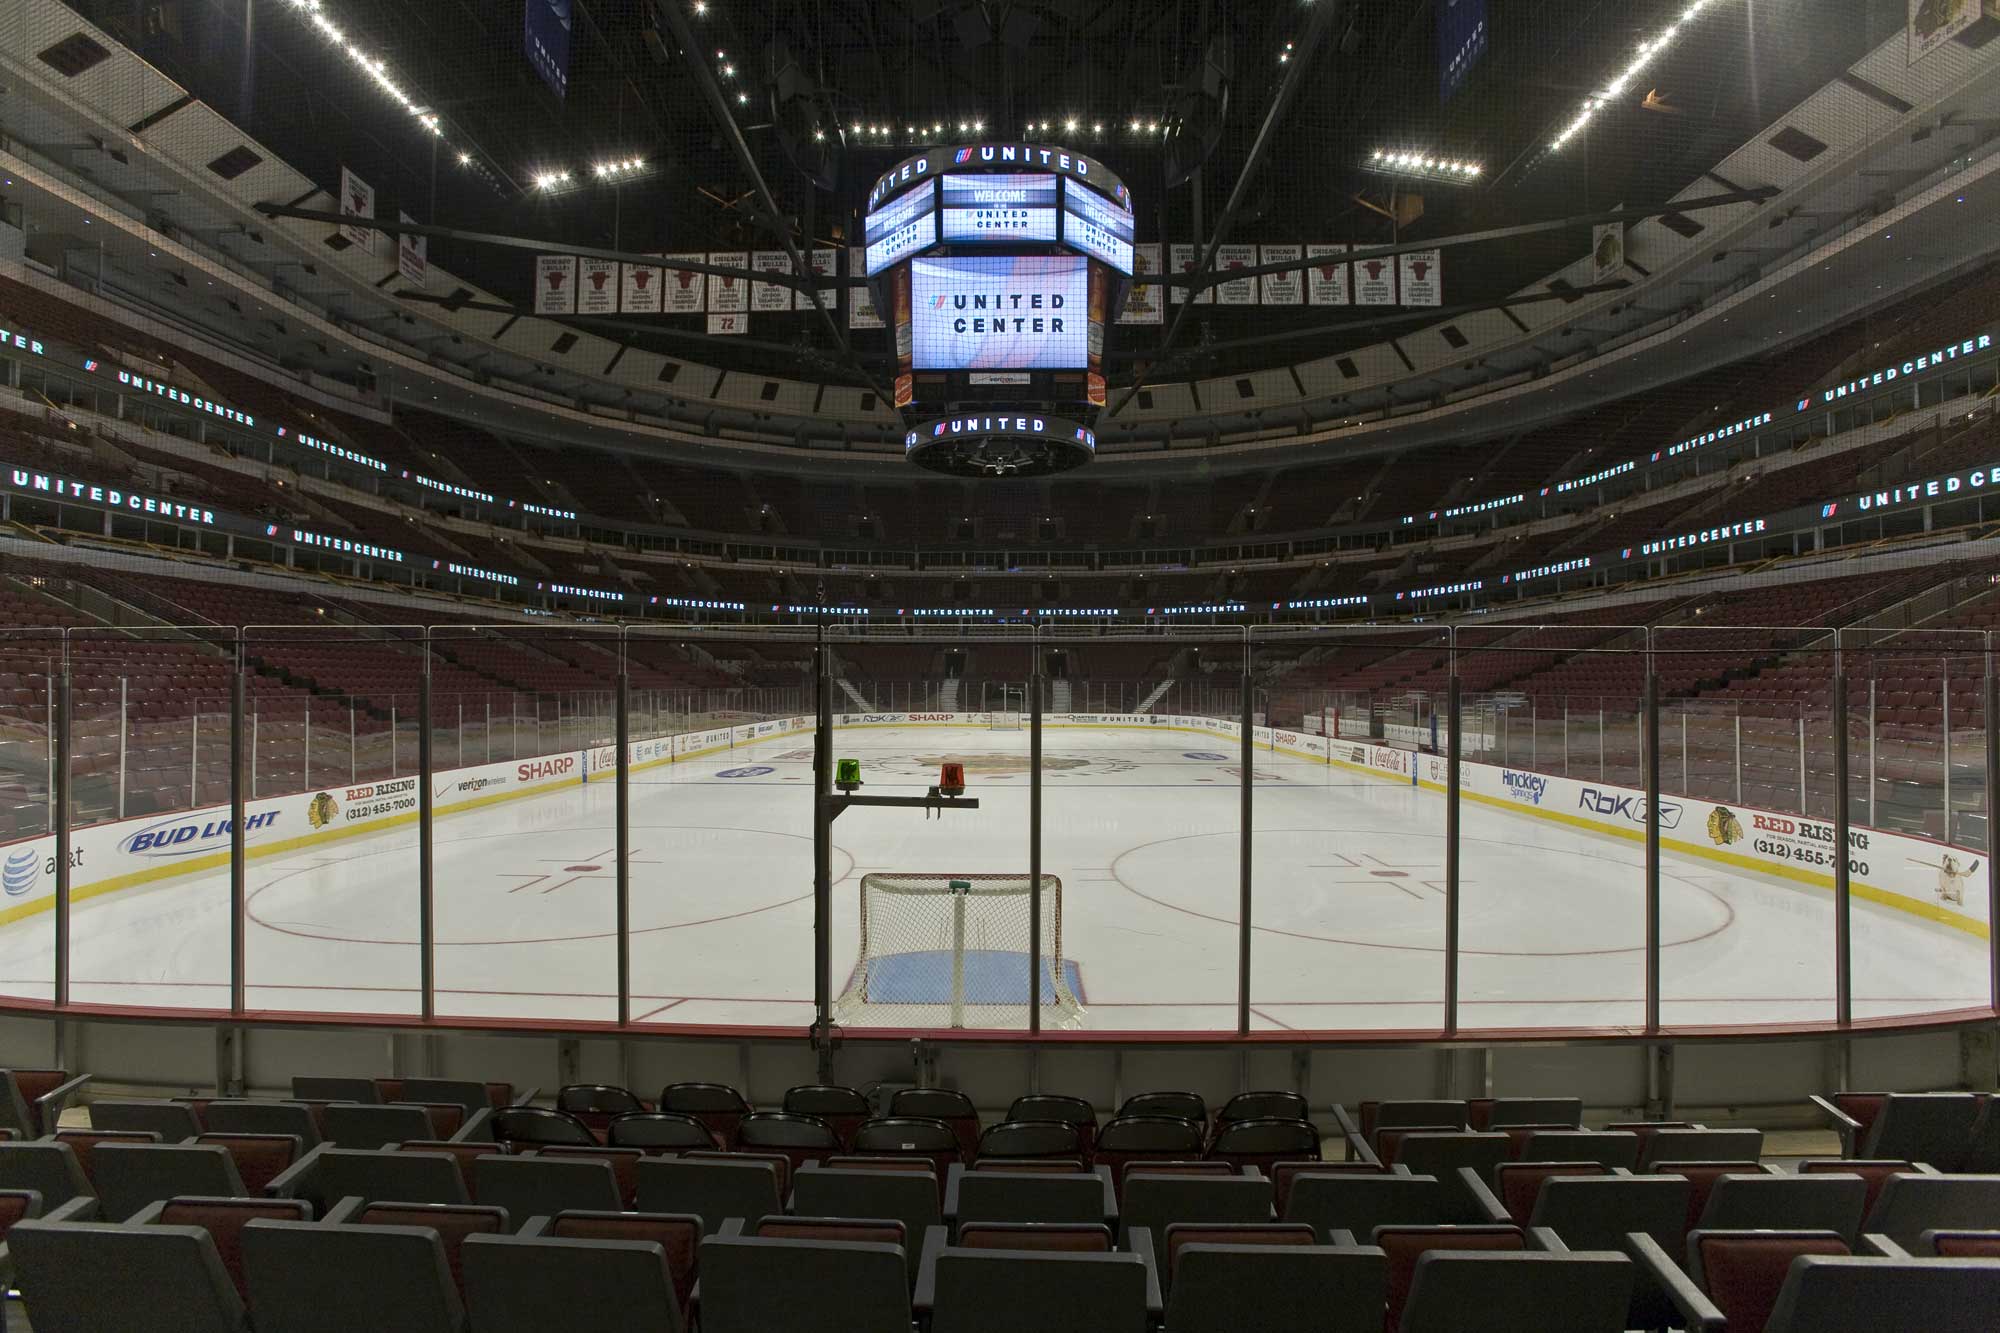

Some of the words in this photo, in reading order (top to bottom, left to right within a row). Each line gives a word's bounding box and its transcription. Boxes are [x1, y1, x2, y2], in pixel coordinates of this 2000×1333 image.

[981, 146, 1088, 175] UNITED
[974, 190, 1027, 202] WELCOME
[977, 210, 1028, 218] UNITED
[885, 224, 917, 246] UNITED
[1085, 224, 1117, 246] UNITED
[953, 294, 1065, 310] UNITED
[721, 318, 734, 329] 72
[953, 317, 1065, 333] CENTER
[951, 417, 1044, 432] UNITED
[908, 713, 954, 721] SHARP
[1275, 732, 1297, 745] SHARP
[518, 757, 574, 782] SHARP
[346, 786, 374, 801] RED
[376, 779, 416, 796] RISING
[458, 777, 488, 792] verizon
[1502, 769, 1547, 796] Hinckley
[1511, 786, 1533, 799] Springs
[346, 805, 371, 821] (312)
[372, 797, 416, 814] 455-7000
[129, 826, 198, 854] BUD
[1753, 814, 1795, 834] RED
[1798, 822, 1870, 850] RISNG
[1753, 837, 1790, 860] (312)
[1793, 847, 1870, 876] 455-700
